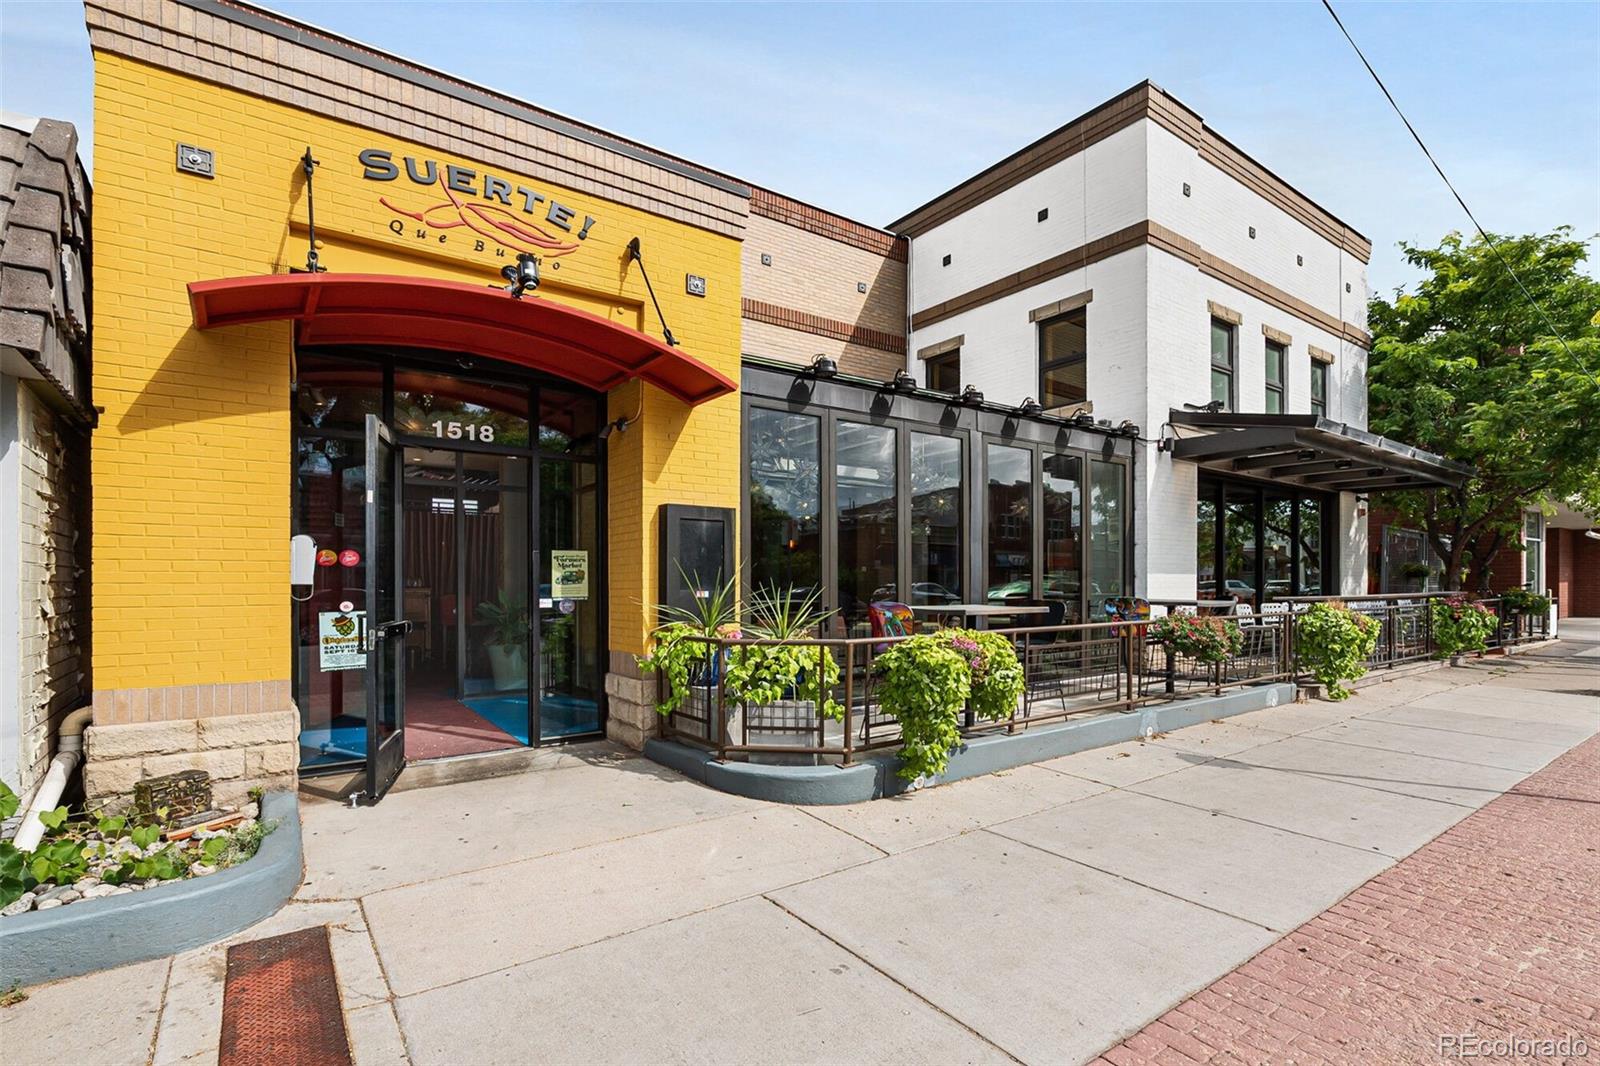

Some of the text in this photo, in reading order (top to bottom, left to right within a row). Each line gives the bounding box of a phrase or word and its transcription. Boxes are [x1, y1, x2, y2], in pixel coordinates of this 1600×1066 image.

[358, 148, 597, 241] SUERTE!
[388, 219, 448, 244] Que
[431, 420, 495, 443] 1518
